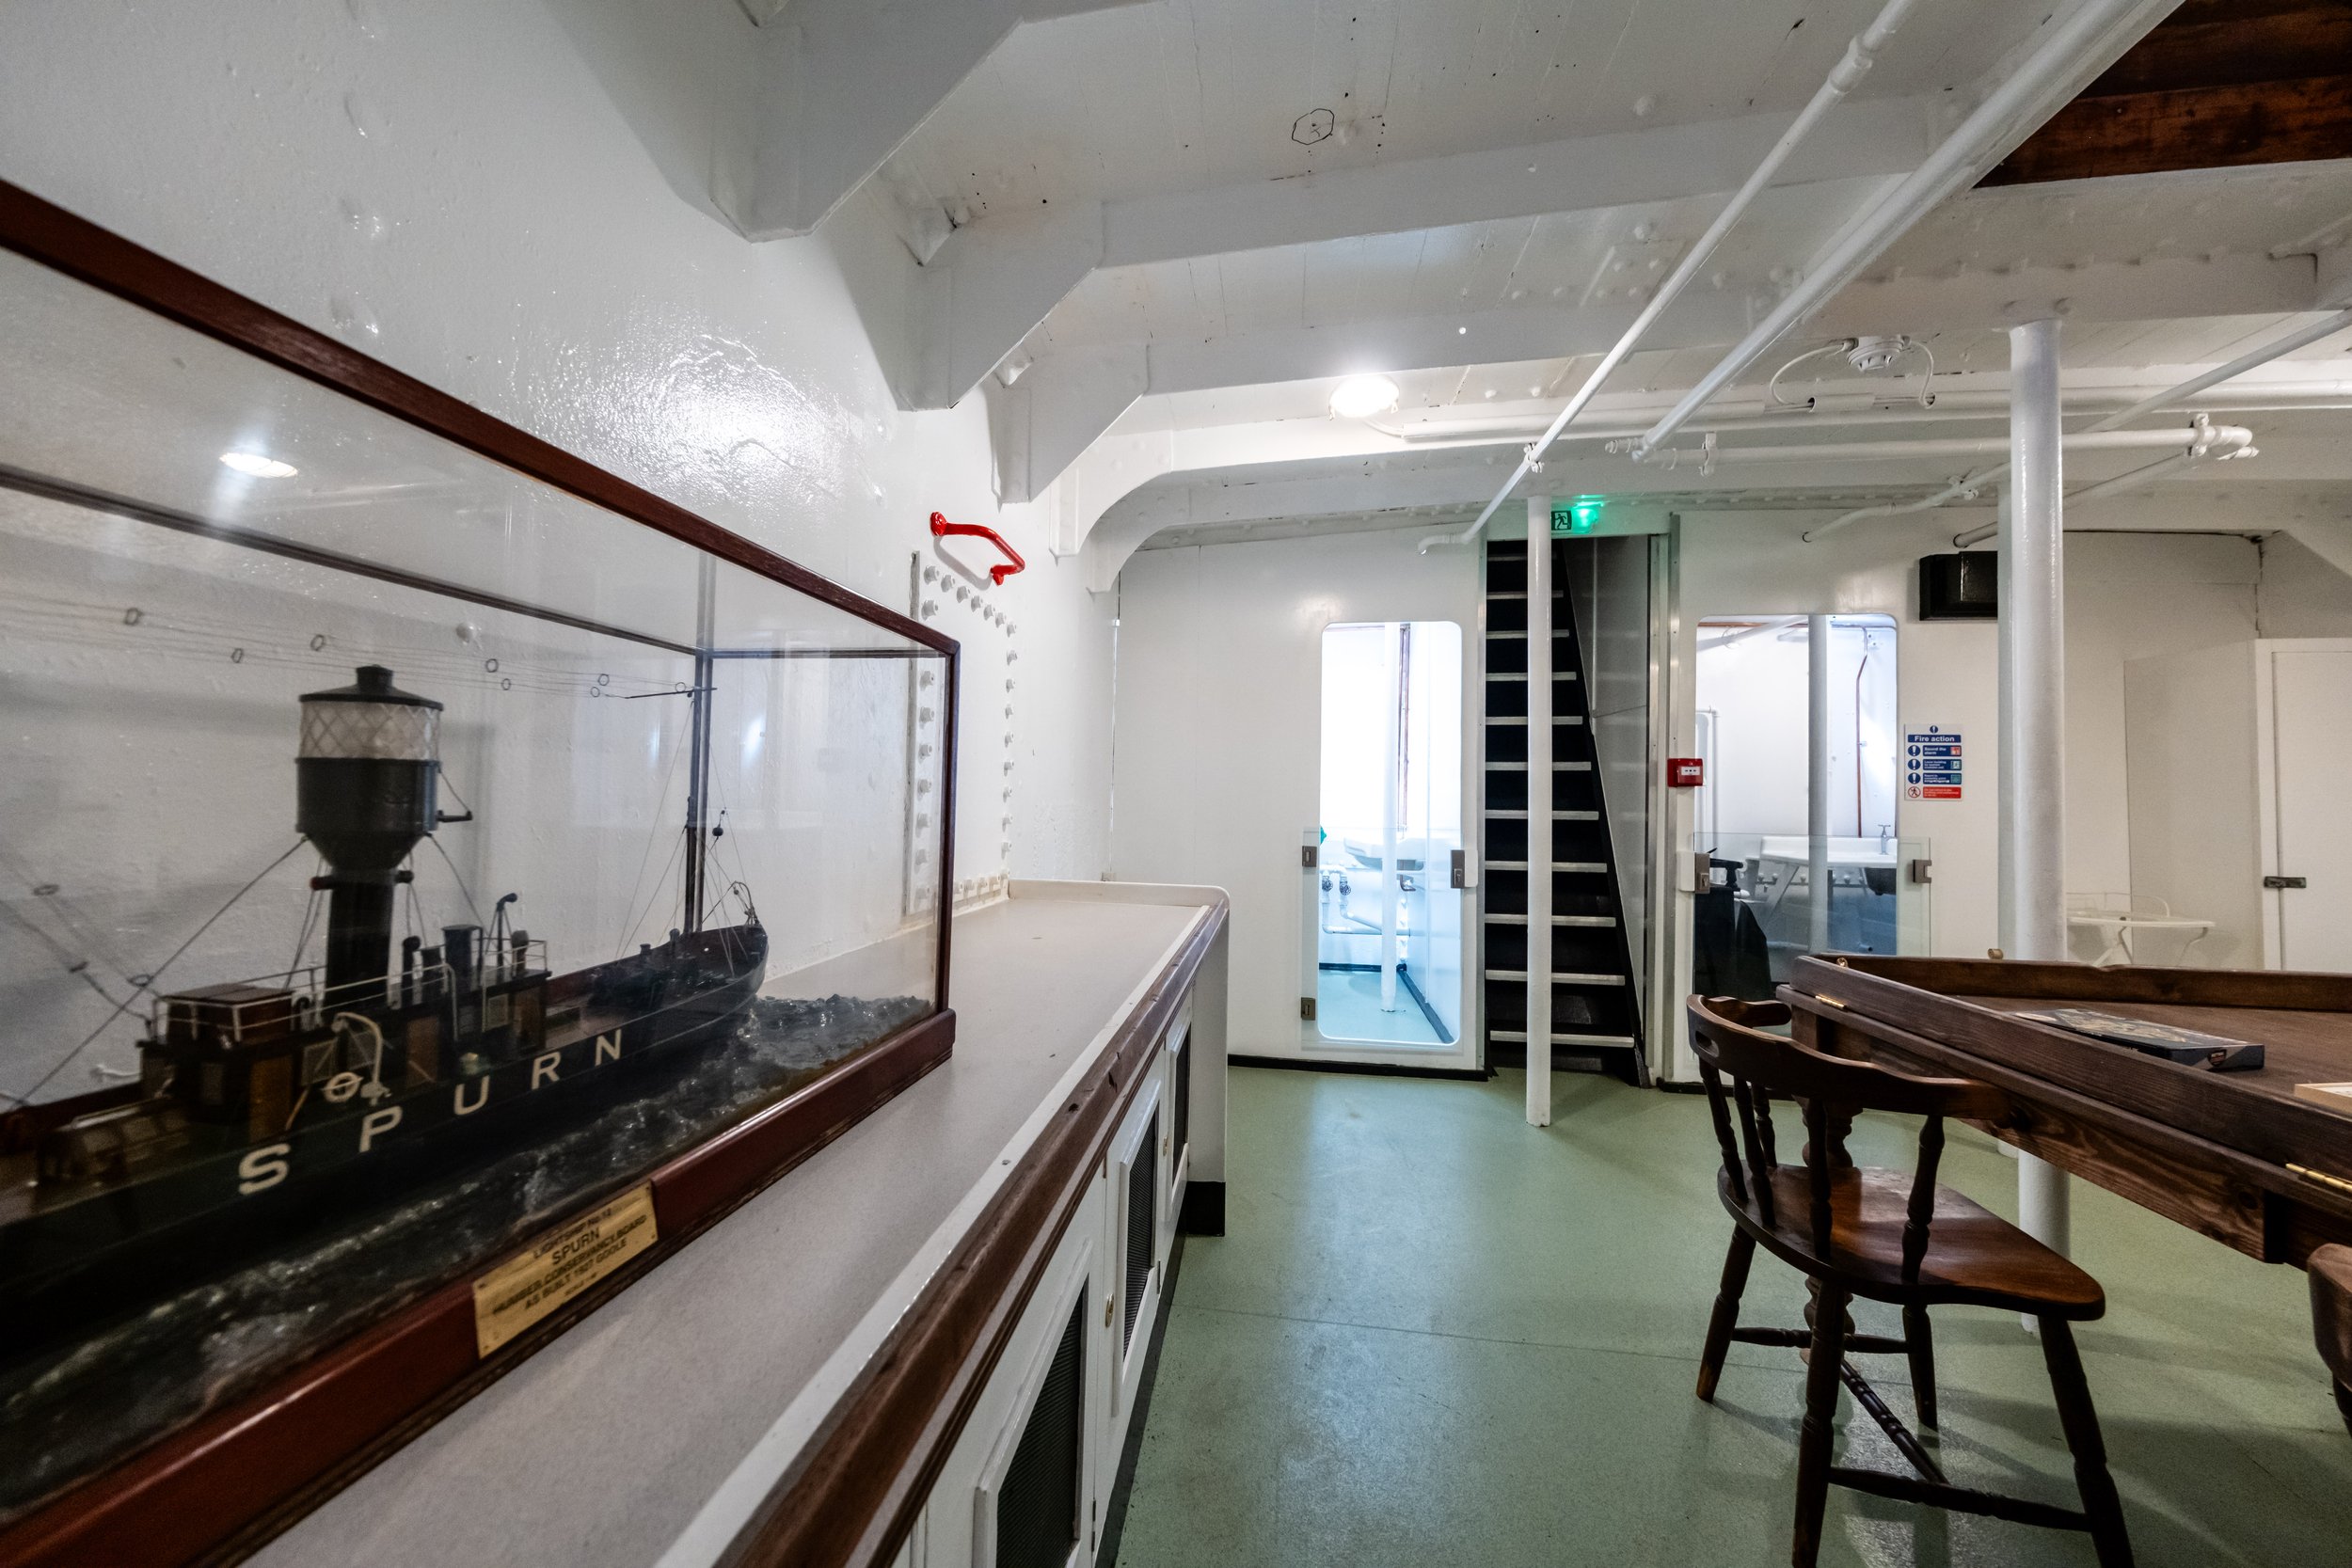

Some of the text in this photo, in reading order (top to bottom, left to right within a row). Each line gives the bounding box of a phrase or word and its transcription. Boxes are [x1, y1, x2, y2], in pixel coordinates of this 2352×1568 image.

[238, 1029, 622, 1195] SPURN
[525, 1292, 540, 1310] AS
[542, 1275, 570, 1298] BUILT
[596, 1238, 627, 1263] GOOLE
[551, 1227, 599, 1265] SPURN
